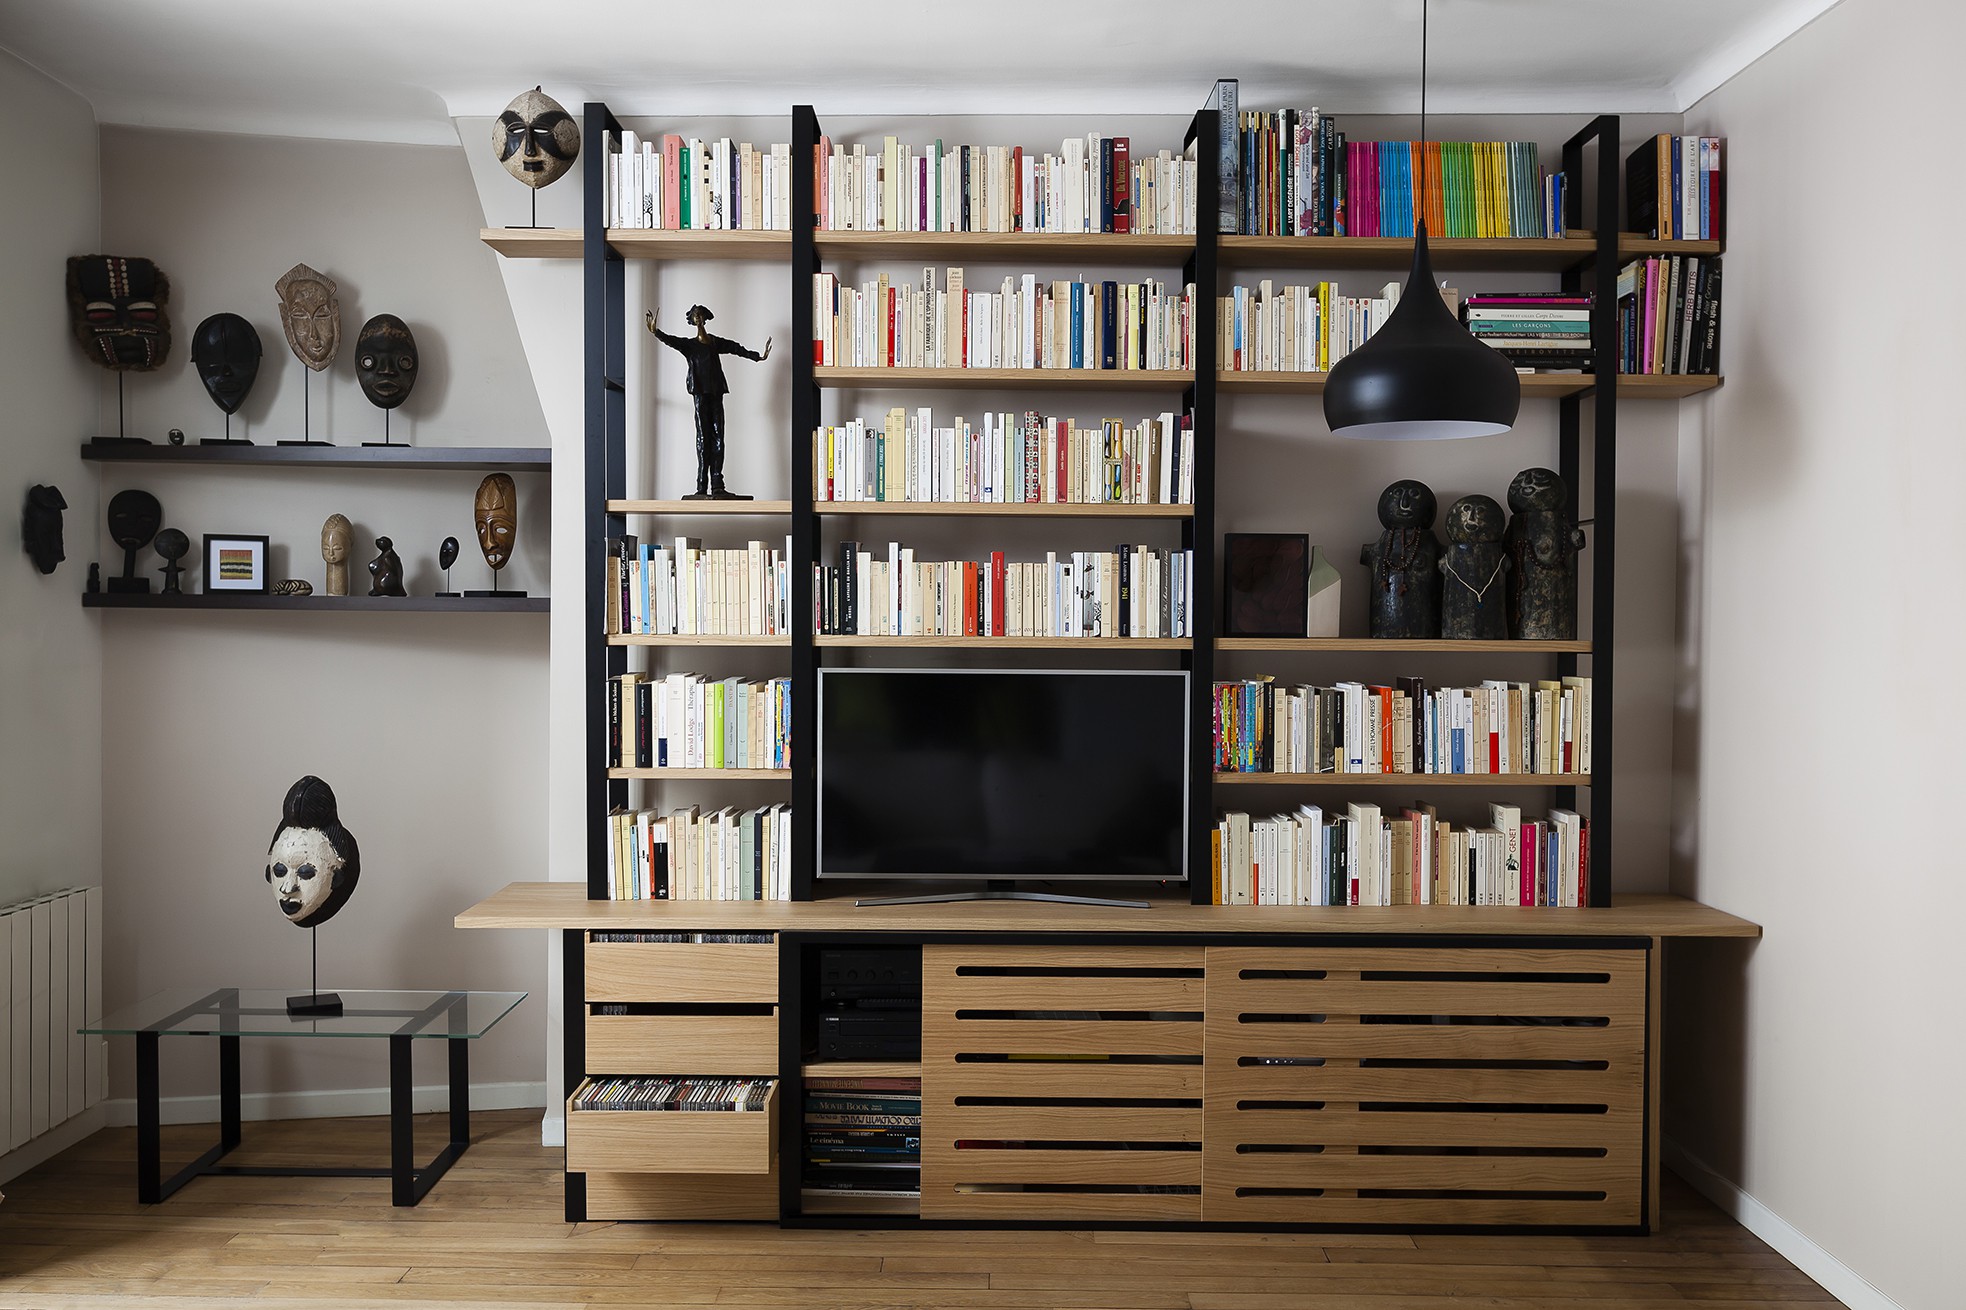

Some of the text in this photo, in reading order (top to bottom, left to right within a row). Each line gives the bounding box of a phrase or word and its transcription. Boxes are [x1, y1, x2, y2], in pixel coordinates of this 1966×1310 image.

[1690, 159, 1696, 167] DE
[1685, 272, 1696, 322] HERB RITTS
[1709, 300, 1718, 318] flesh
[1706, 329, 1715, 350] stone
[820, 1102, 845, 1110] MOVIE
[847, 1102, 869, 1111] BOOK
